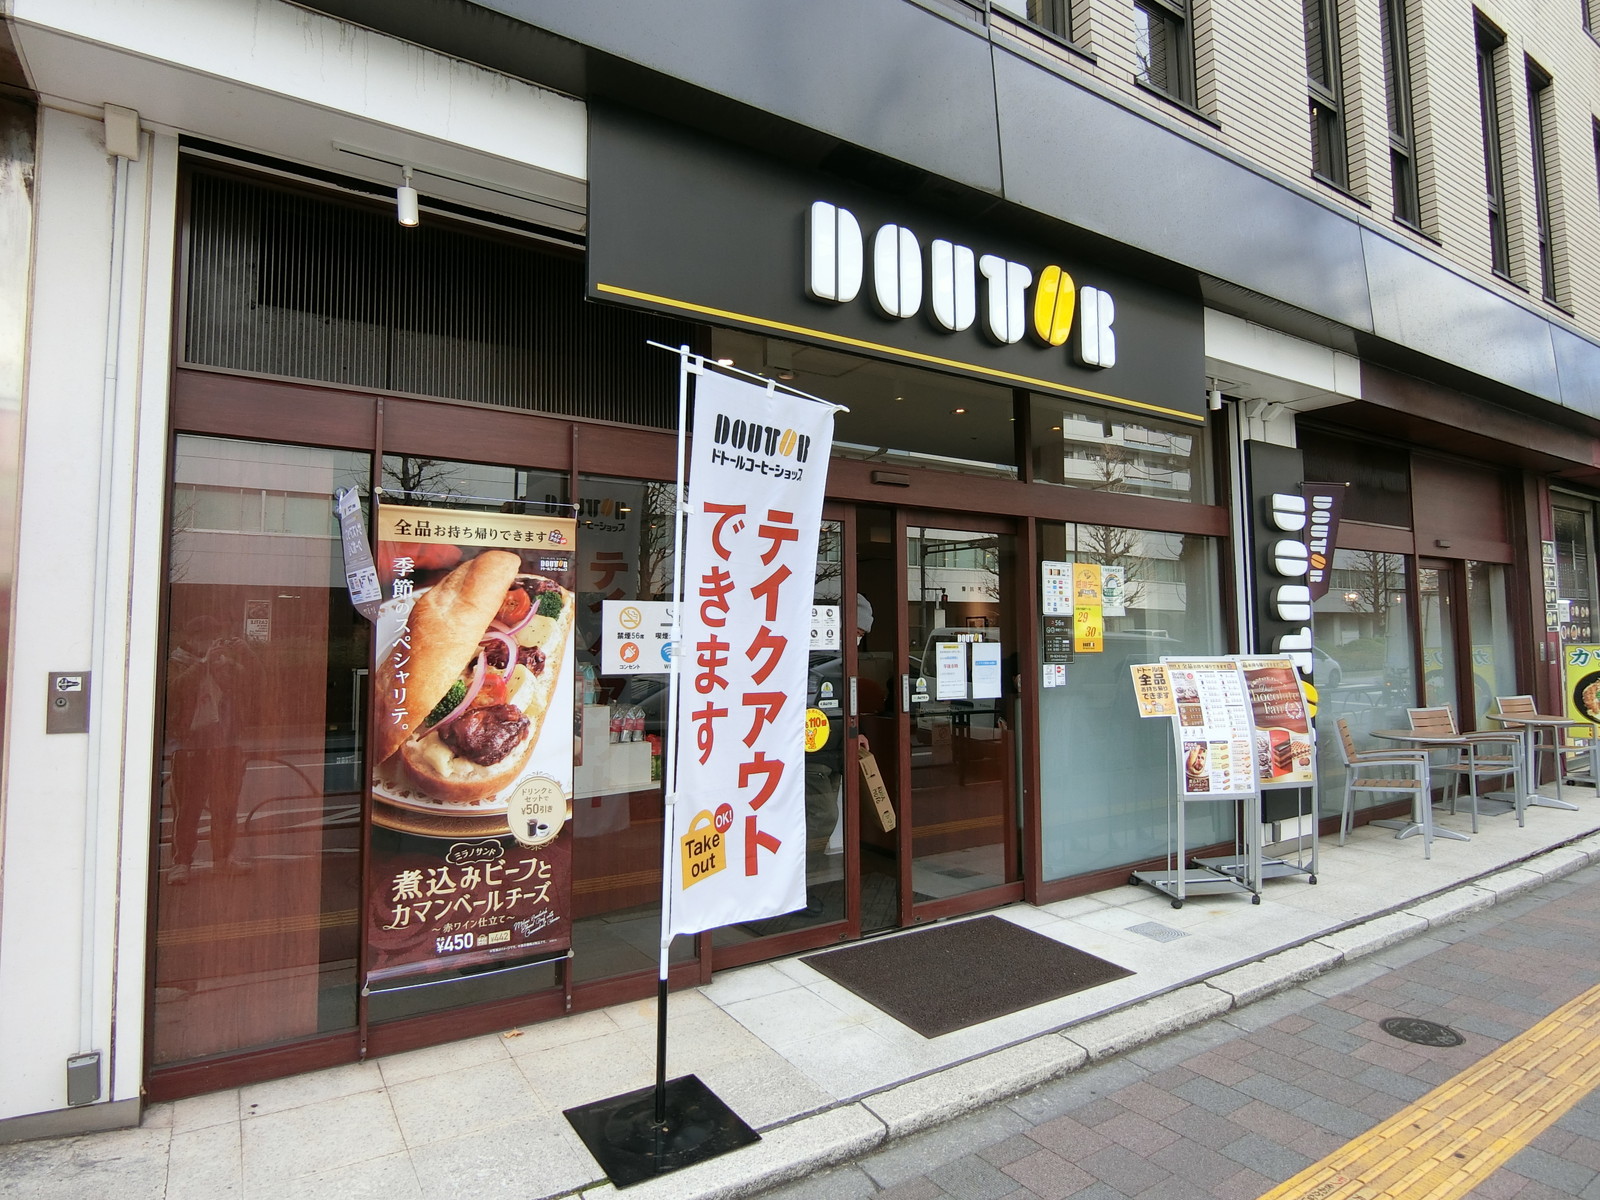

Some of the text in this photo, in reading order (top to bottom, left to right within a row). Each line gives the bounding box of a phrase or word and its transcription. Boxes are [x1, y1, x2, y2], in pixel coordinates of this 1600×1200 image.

[810, 201, 1116, 369] DOUTOR
[714, 413, 811, 463] DOUTOR
[393, 518, 547, 544] 全品お持ち帰りできます
[1309, 495, 1333, 583] DOUTOR
[540, 559, 568, 568] DOUTOR
[1078, 611, 1089, 623] 29
[691, 501, 747, 766] できます
[1085, 626, 1097, 637] 30
[391, 556, 415, 732] 季節のスペシャリテ。
[1136, 666, 1164, 674] ドトールは
[1138, 673, 1167, 686] 全品
[737, 508, 799, 877] テイクアウト
[1141, 692, 1170, 700] できます
[521, 787, 553, 795] ドリンクと
[521, 803, 553, 815] ¥50引き
[715, 809, 733, 828] OK!
[454, 847, 497, 861] ミラノサンド
[685, 832, 720, 859] Take
[691, 853, 716, 878] out
[392, 857, 552, 902] 煮込みビーフと
[382, 881, 552, 931] カマンベールチーズ
[436, 932, 474, 953] ¥450
